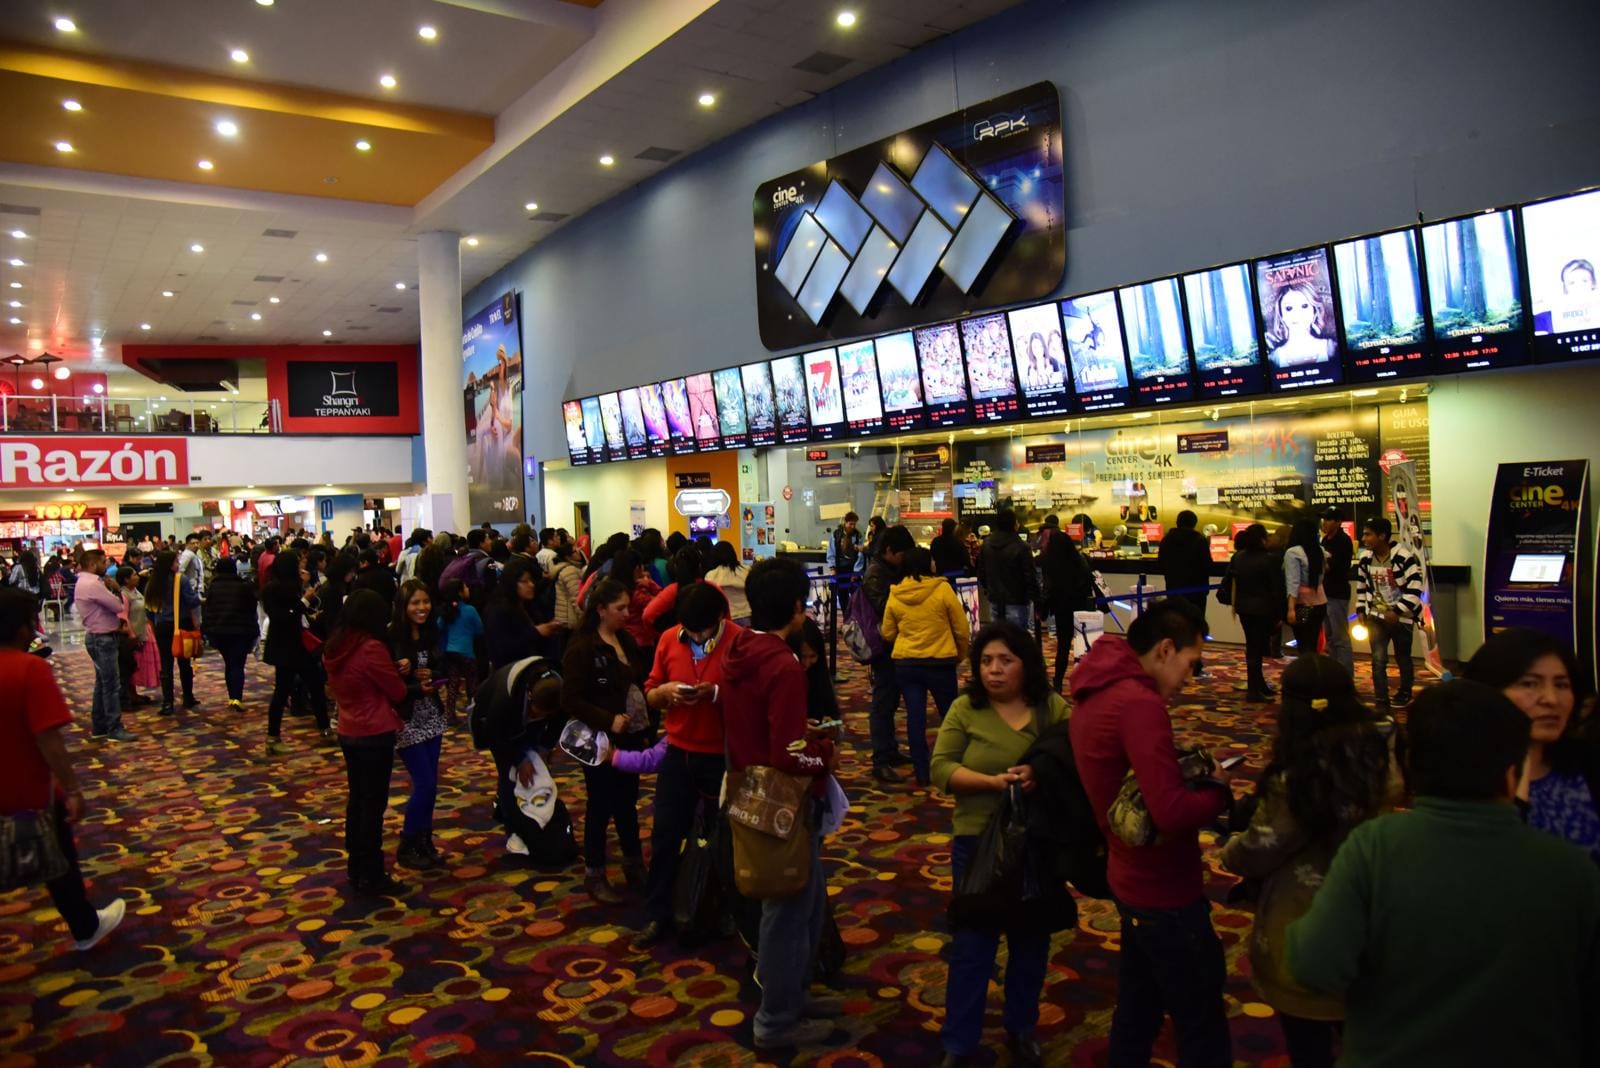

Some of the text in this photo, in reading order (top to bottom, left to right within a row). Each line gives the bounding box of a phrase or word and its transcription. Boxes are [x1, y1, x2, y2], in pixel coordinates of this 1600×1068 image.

[979, 114, 1027, 141] RPK
[773, 186, 797, 204] cine
[810, 360, 832, 393] 7
[322, 394, 359, 408] Shangri
[314, 407, 371, 416] TEPPANYAKI
[1393, 419, 1406, 429] DE
[1106, 431, 1157, 461] cine
[1263, 428, 1299, 461] 4K
[1317, 440, 1338, 448] Entrada
[1317, 447, 1338, 455] Entrada
[1, 442, 177, 483] Razón
[1107, 454, 1172, 468] CENTER 4K
[1131, 471, 1143, 481] TUS
[1523, 466, 1564, 478] E-Ticket
[1336, 481, 1365, 489] Domingos
[1508, 481, 1564, 506] cine
[1311, 496, 1326, 505] partir
[1509, 500, 1544, 509] CENTER
[34, 503, 87, 520] TOBY
[1494, 595, 1519, 603] Quieres
[1536, 596, 1555, 604] tienes
